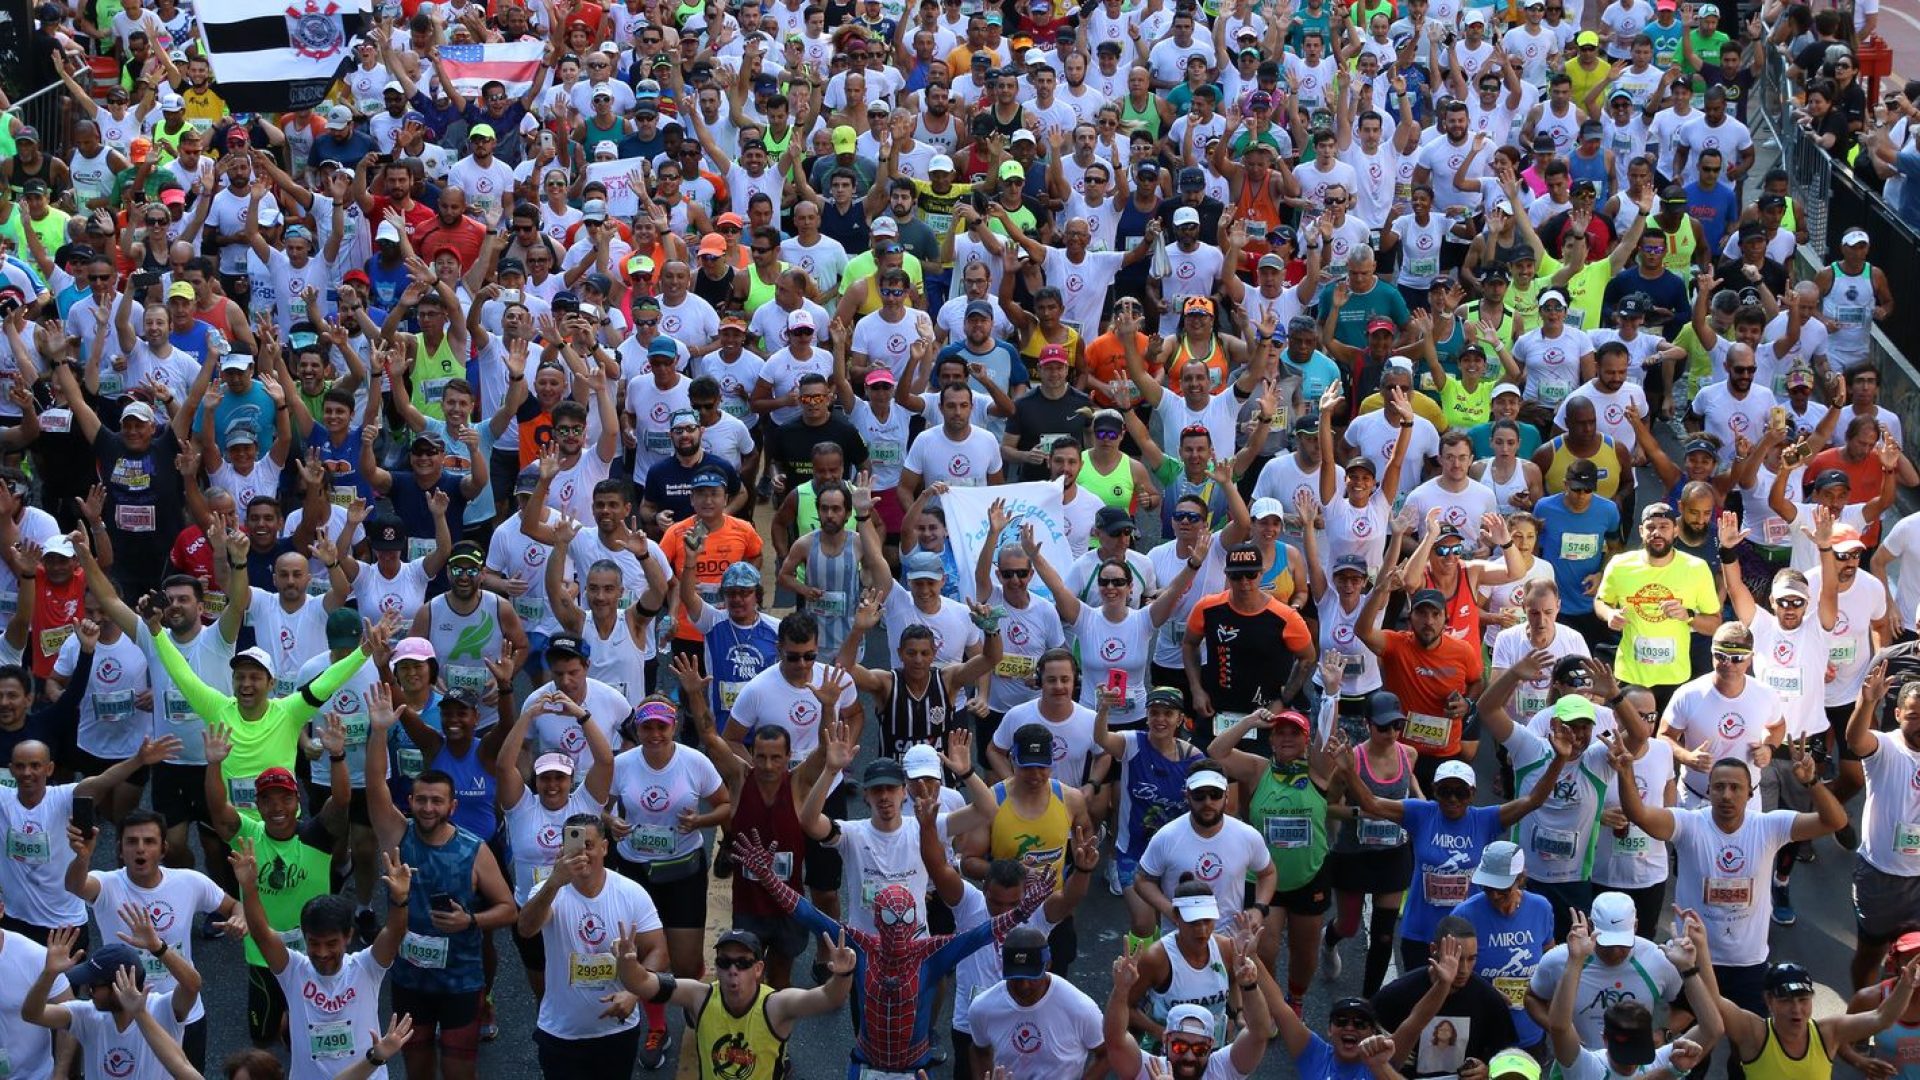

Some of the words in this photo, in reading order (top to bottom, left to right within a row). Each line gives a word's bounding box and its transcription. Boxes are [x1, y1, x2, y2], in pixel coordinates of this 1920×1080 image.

[1568, 542, 1590, 553] 5746
[697, 560, 731, 573] BDO
[1641, 646, 1670, 658] 10396
[454, 676, 478, 686] 9584
[1412, 723, 1443, 738] 27233
[641, 835, 668, 848] 8260
[1618, 837, 1646, 849] 4955
[407, 943, 440, 959] 10392
[577, 964, 612, 977] 29932
[316, 1034, 347, 1048] 7490
